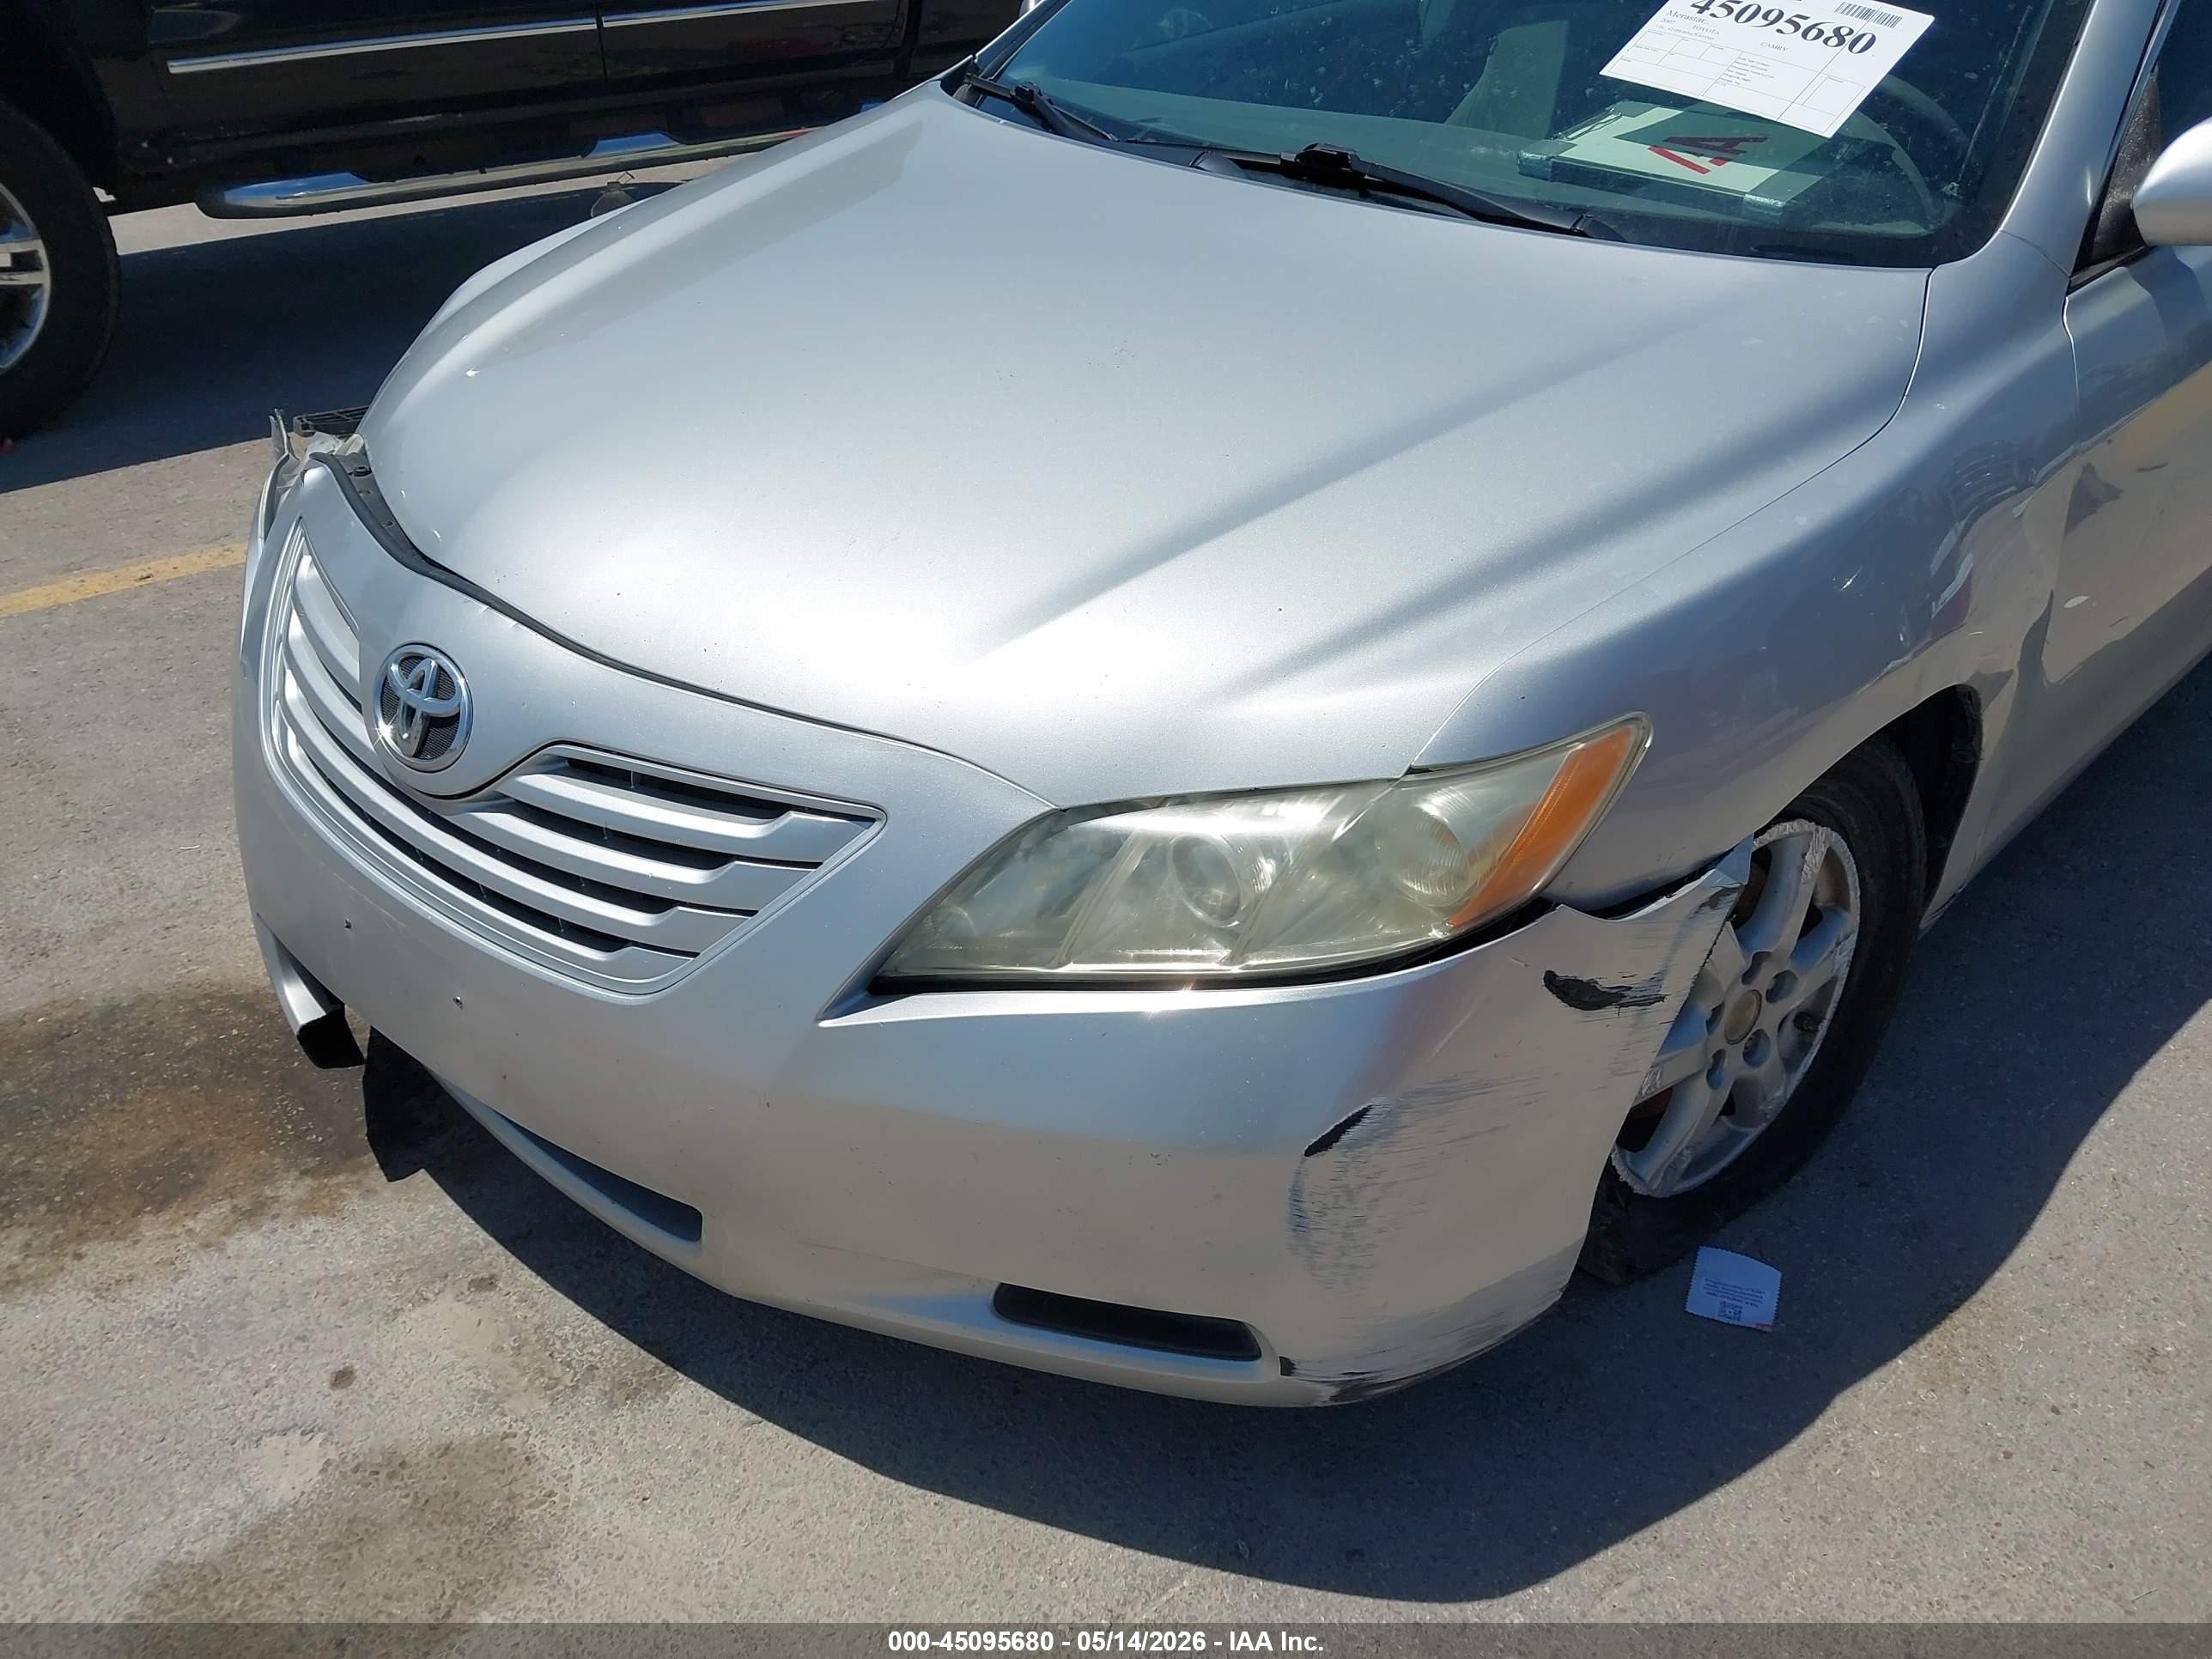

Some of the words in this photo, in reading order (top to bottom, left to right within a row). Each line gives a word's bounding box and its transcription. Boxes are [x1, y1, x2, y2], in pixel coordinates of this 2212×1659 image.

[1690, 0, 1877, 55] 45095680
[1692, 24, 1720, 35] TOYOTA
[1759, 41, 1790, 52] CAMRY
